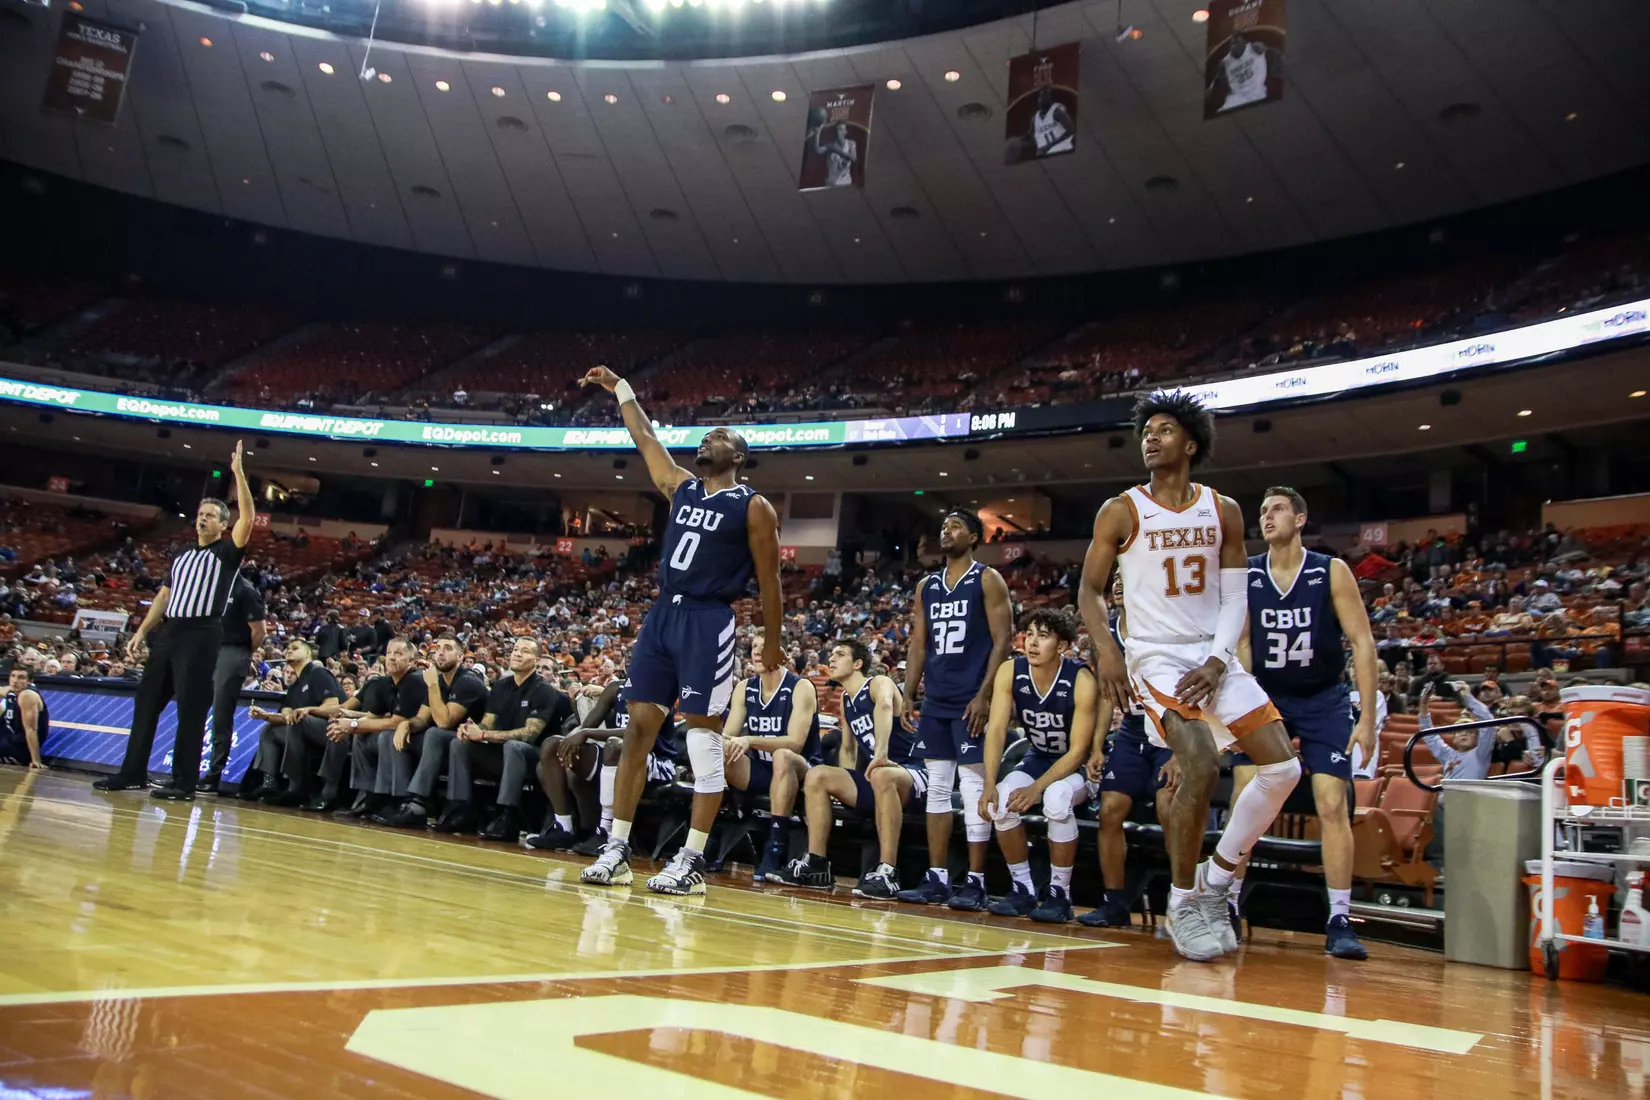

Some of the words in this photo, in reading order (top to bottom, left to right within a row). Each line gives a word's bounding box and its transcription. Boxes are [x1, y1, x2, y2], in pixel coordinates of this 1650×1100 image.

[78, 23, 121, 44] TEXAS
[22, 385, 81, 404] DEPOT
[117, 397, 220, 421] EQDepot.com
[997, 411, 1016, 429] PM
[260, 413, 335, 432] EQUIPMENT
[333, 420, 384, 436] DEPOT
[422, 426, 521, 444] EQDepot.com
[675, 504, 724, 532] CBU
[1144, 526, 1217, 551] TEXAS
[1363, 528, 1383, 541] 49
[558, 541, 573, 552] 22
[669, 530, 701, 571] 0
[781, 548, 796, 560] 21
[1004, 547, 1021, 559] 20
[1162, 553, 1207, 598] 13
[930, 600, 968, 620] CBU
[1260, 606, 1312, 629] CBU
[932, 620, 966, 656] 32
[1264, 631, 1314, 669] 34
[748, 715, 782, 732] CBU
[850, 714, 874, 736] CBU
[1022, 708, 1064, 728] CBU
[1029, 728, 1067, 754] 23
[1565, 717, 1582, 748] G
